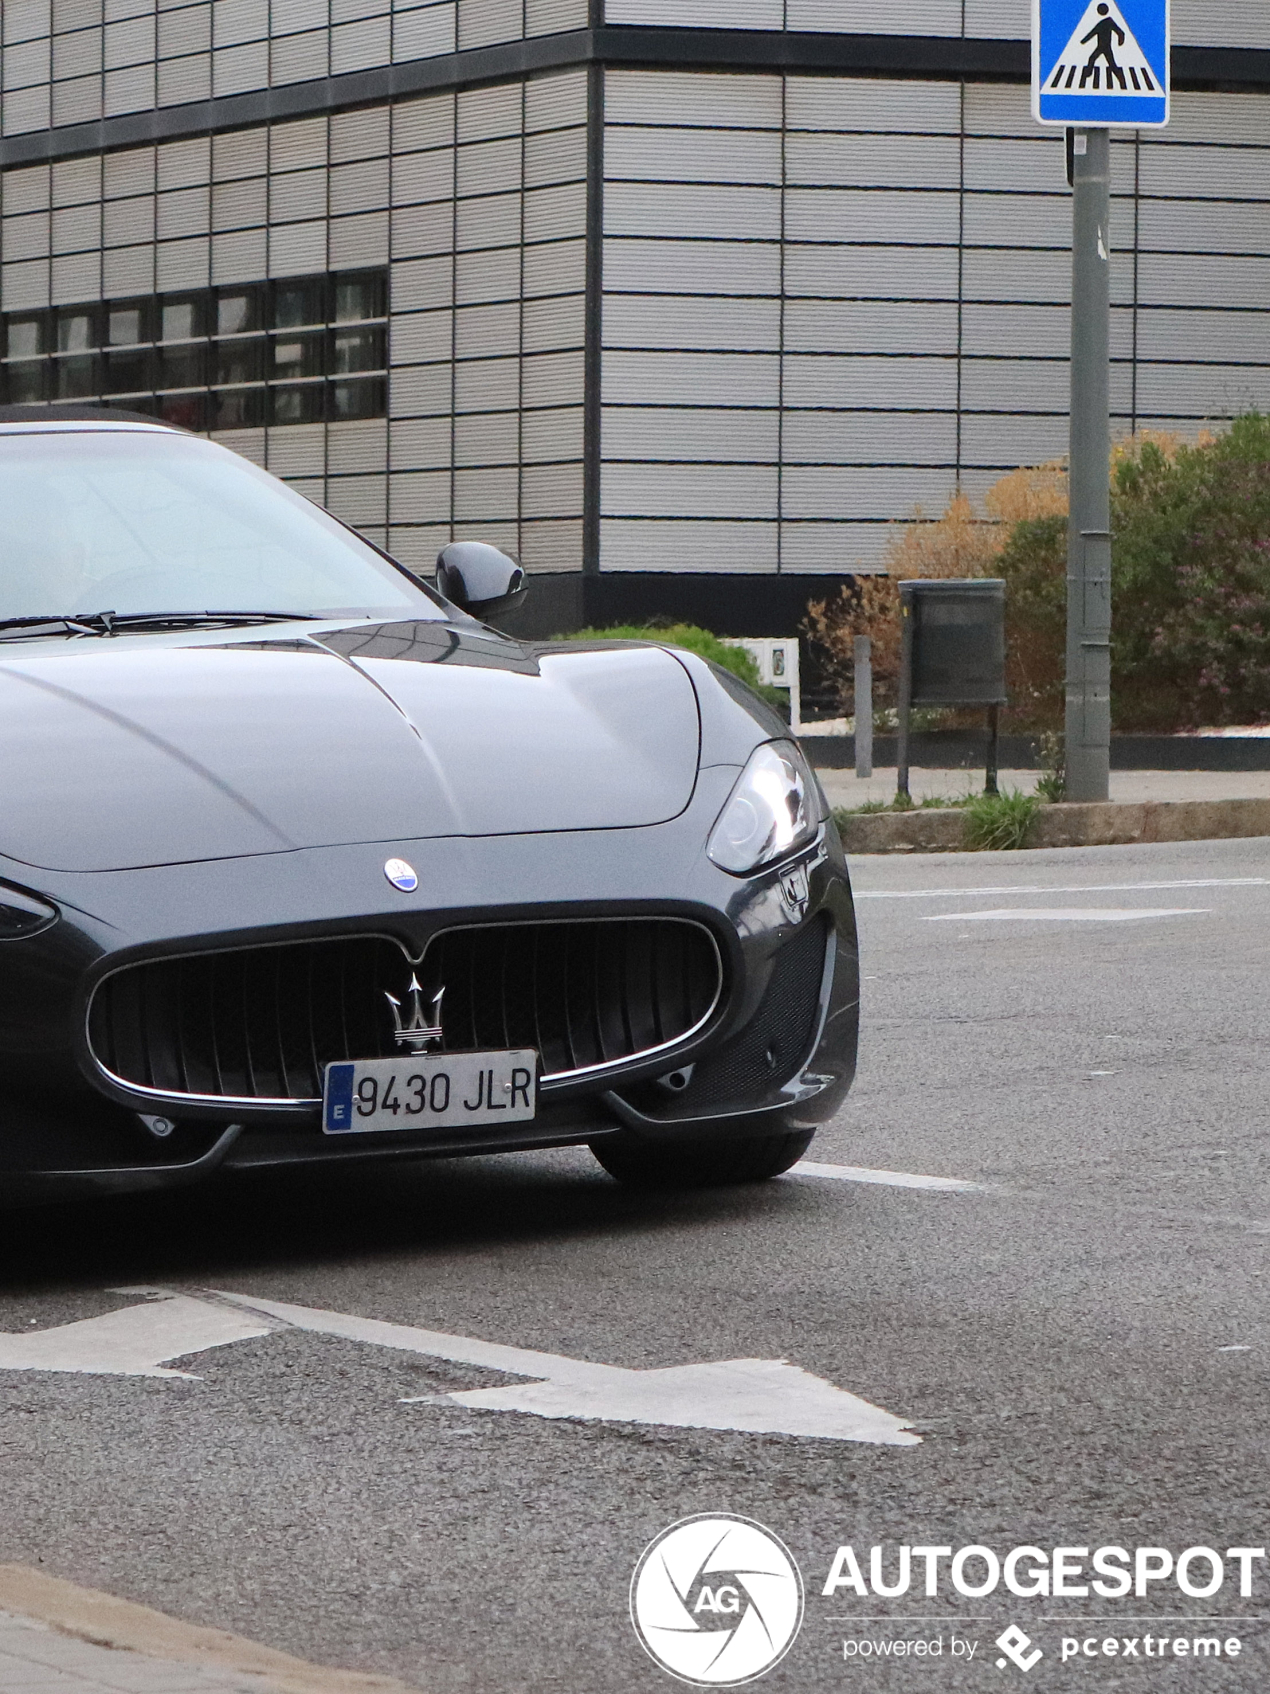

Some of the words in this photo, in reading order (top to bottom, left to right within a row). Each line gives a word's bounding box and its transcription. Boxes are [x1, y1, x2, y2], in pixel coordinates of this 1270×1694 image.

[333, 1104, 345, 1120] E
[356, 1072, 451, 1118] 9430
[463, 1067, 532, 1112] JLR
